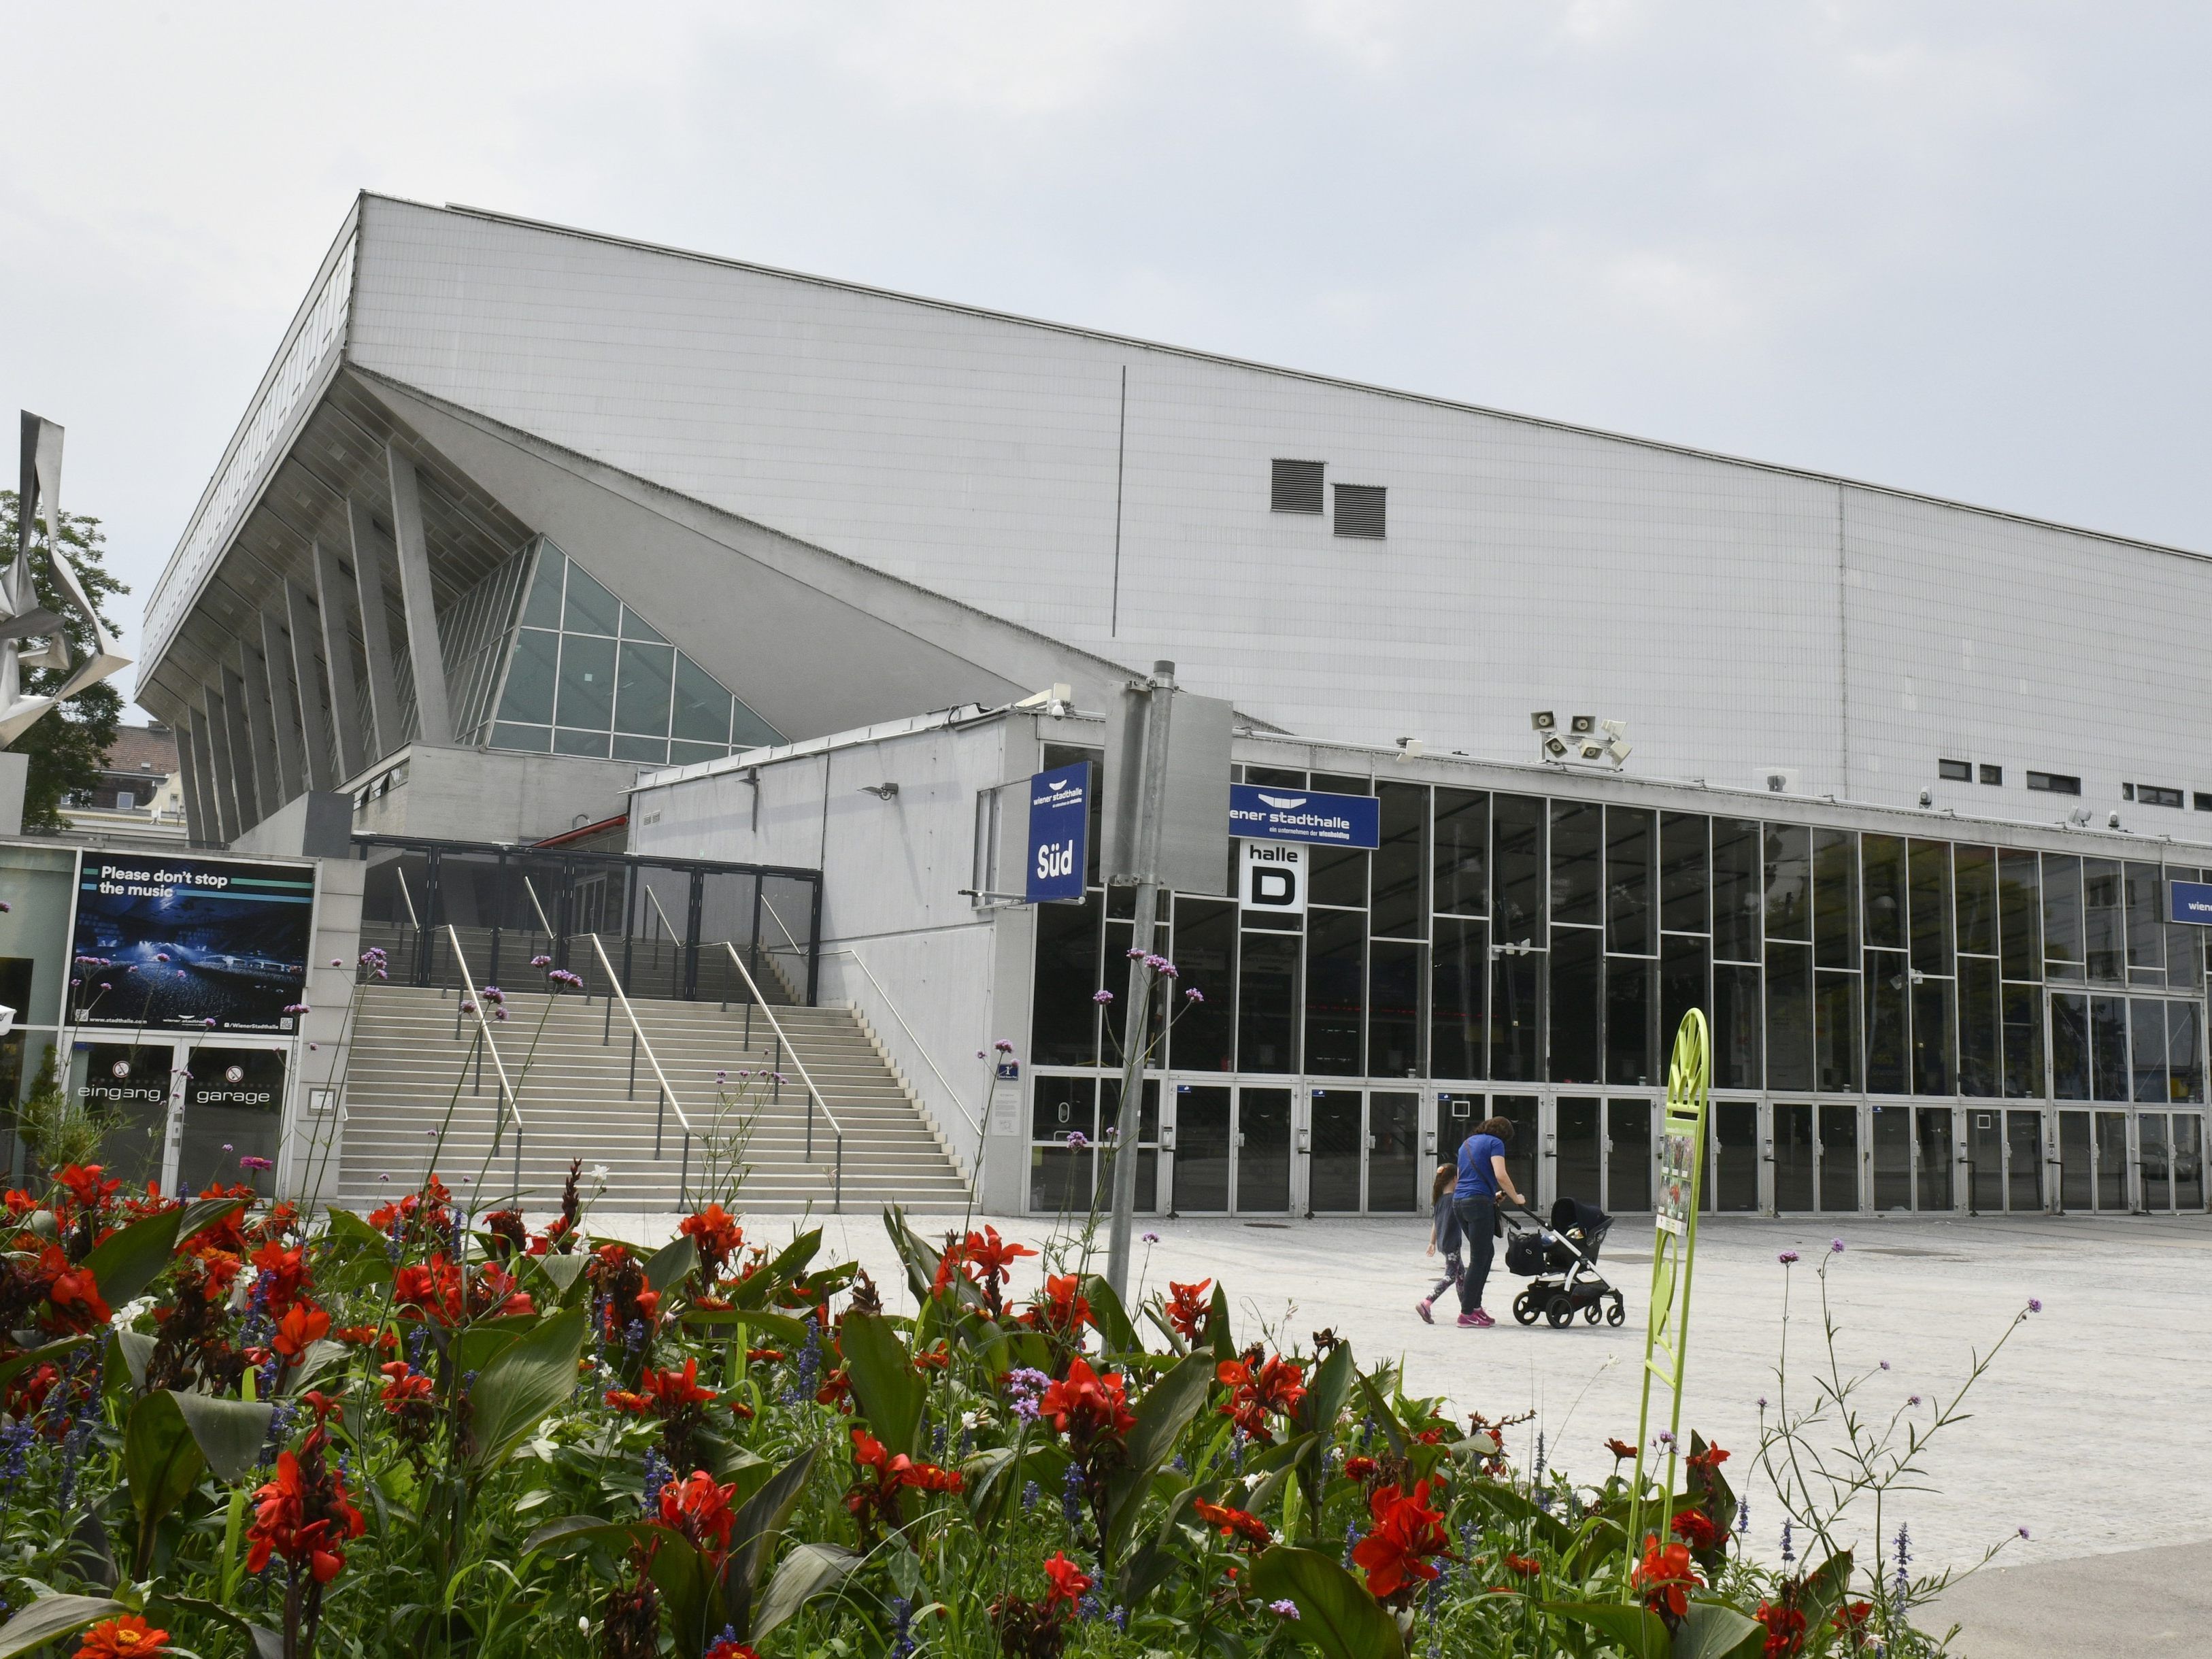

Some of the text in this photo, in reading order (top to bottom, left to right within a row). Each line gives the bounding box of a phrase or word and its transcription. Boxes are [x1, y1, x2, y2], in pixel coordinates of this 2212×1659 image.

[1033, 795, 1052, 805] wiener
[1052, 787, 1082, 801] stadthalle
[1230, 809, 1350, 829] ener stadthalle
[1277, 828, 1309, 836] unternehmen
[1037, 839, 1073, 879] Süd
[1250, 844, 1298, 862] halle
[101, 866, 228, 888] Please don't stop
[1252, 866, 1295, 905] D
[99, 882, 173, 897] the music
[2188, 901, 2212, 911] wien
[78, 1084, 161, 1101] eingang
[197, 1090, 270, 1105] garage
